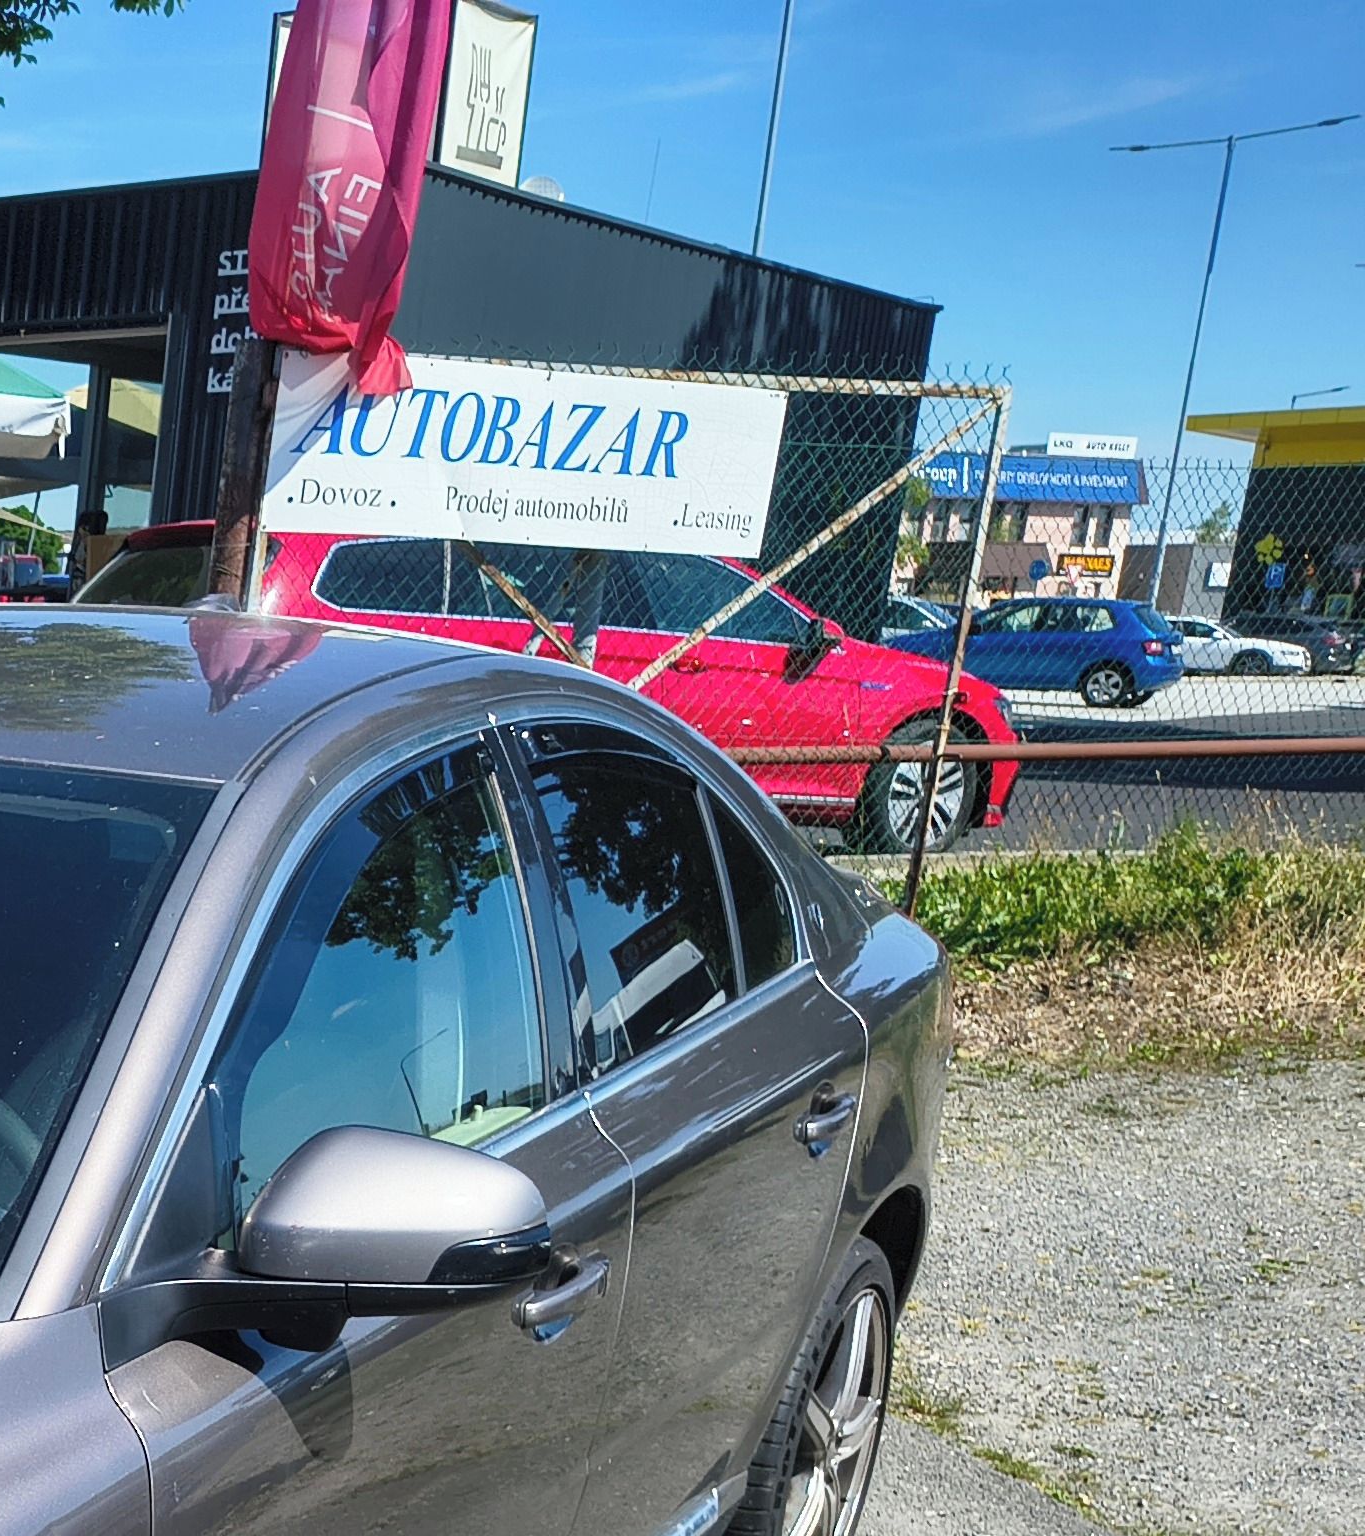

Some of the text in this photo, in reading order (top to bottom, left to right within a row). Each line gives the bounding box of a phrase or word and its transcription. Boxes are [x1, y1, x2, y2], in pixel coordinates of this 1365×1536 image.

[290, 383, 689, 479] AUTOBAZAR
[446, 485, 510, 522] Prodej
[514, 496, 629, 524] automobilů
